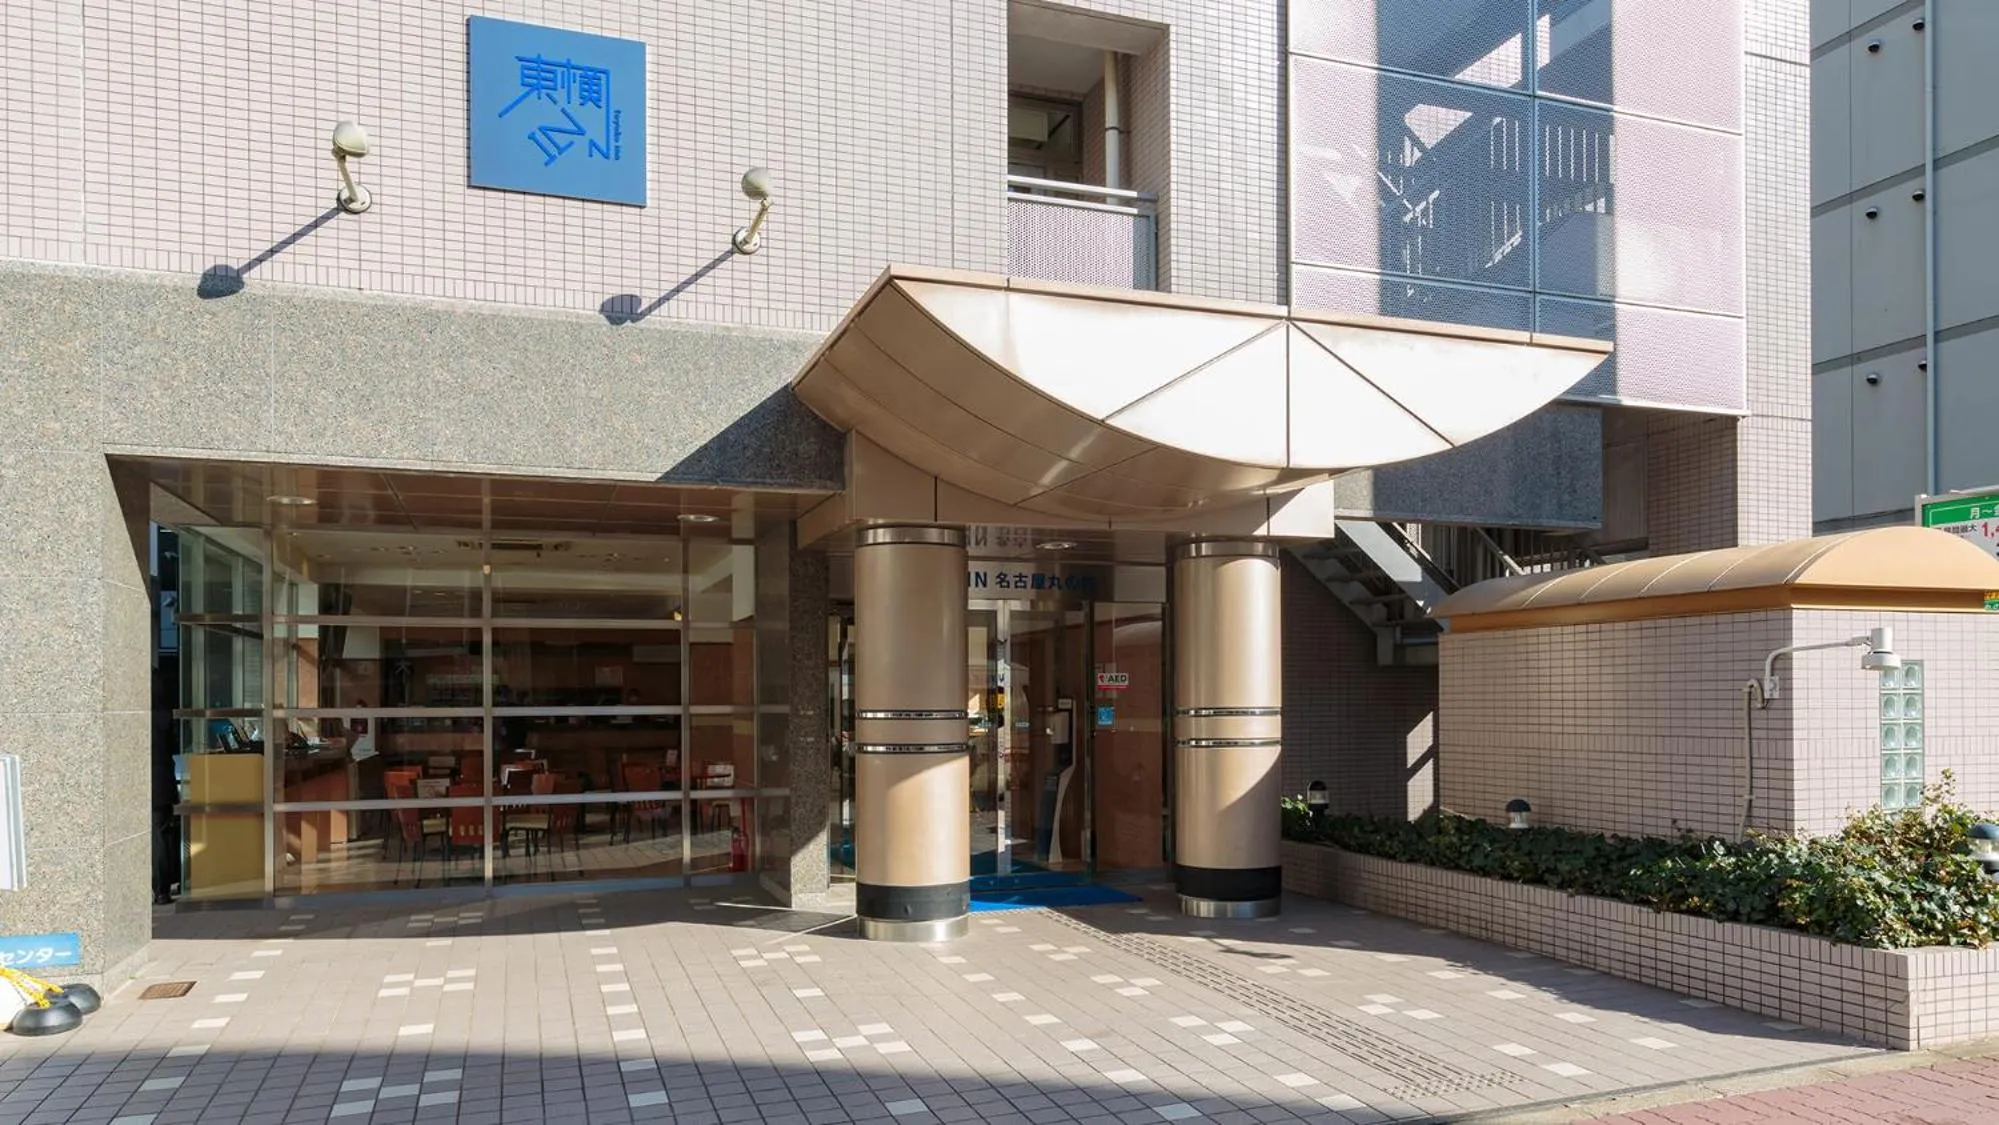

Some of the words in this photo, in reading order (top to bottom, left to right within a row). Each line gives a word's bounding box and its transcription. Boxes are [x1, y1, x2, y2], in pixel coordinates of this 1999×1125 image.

[1106, 673, 1127, 683] AED
[0, 947, 72, 967] センター
